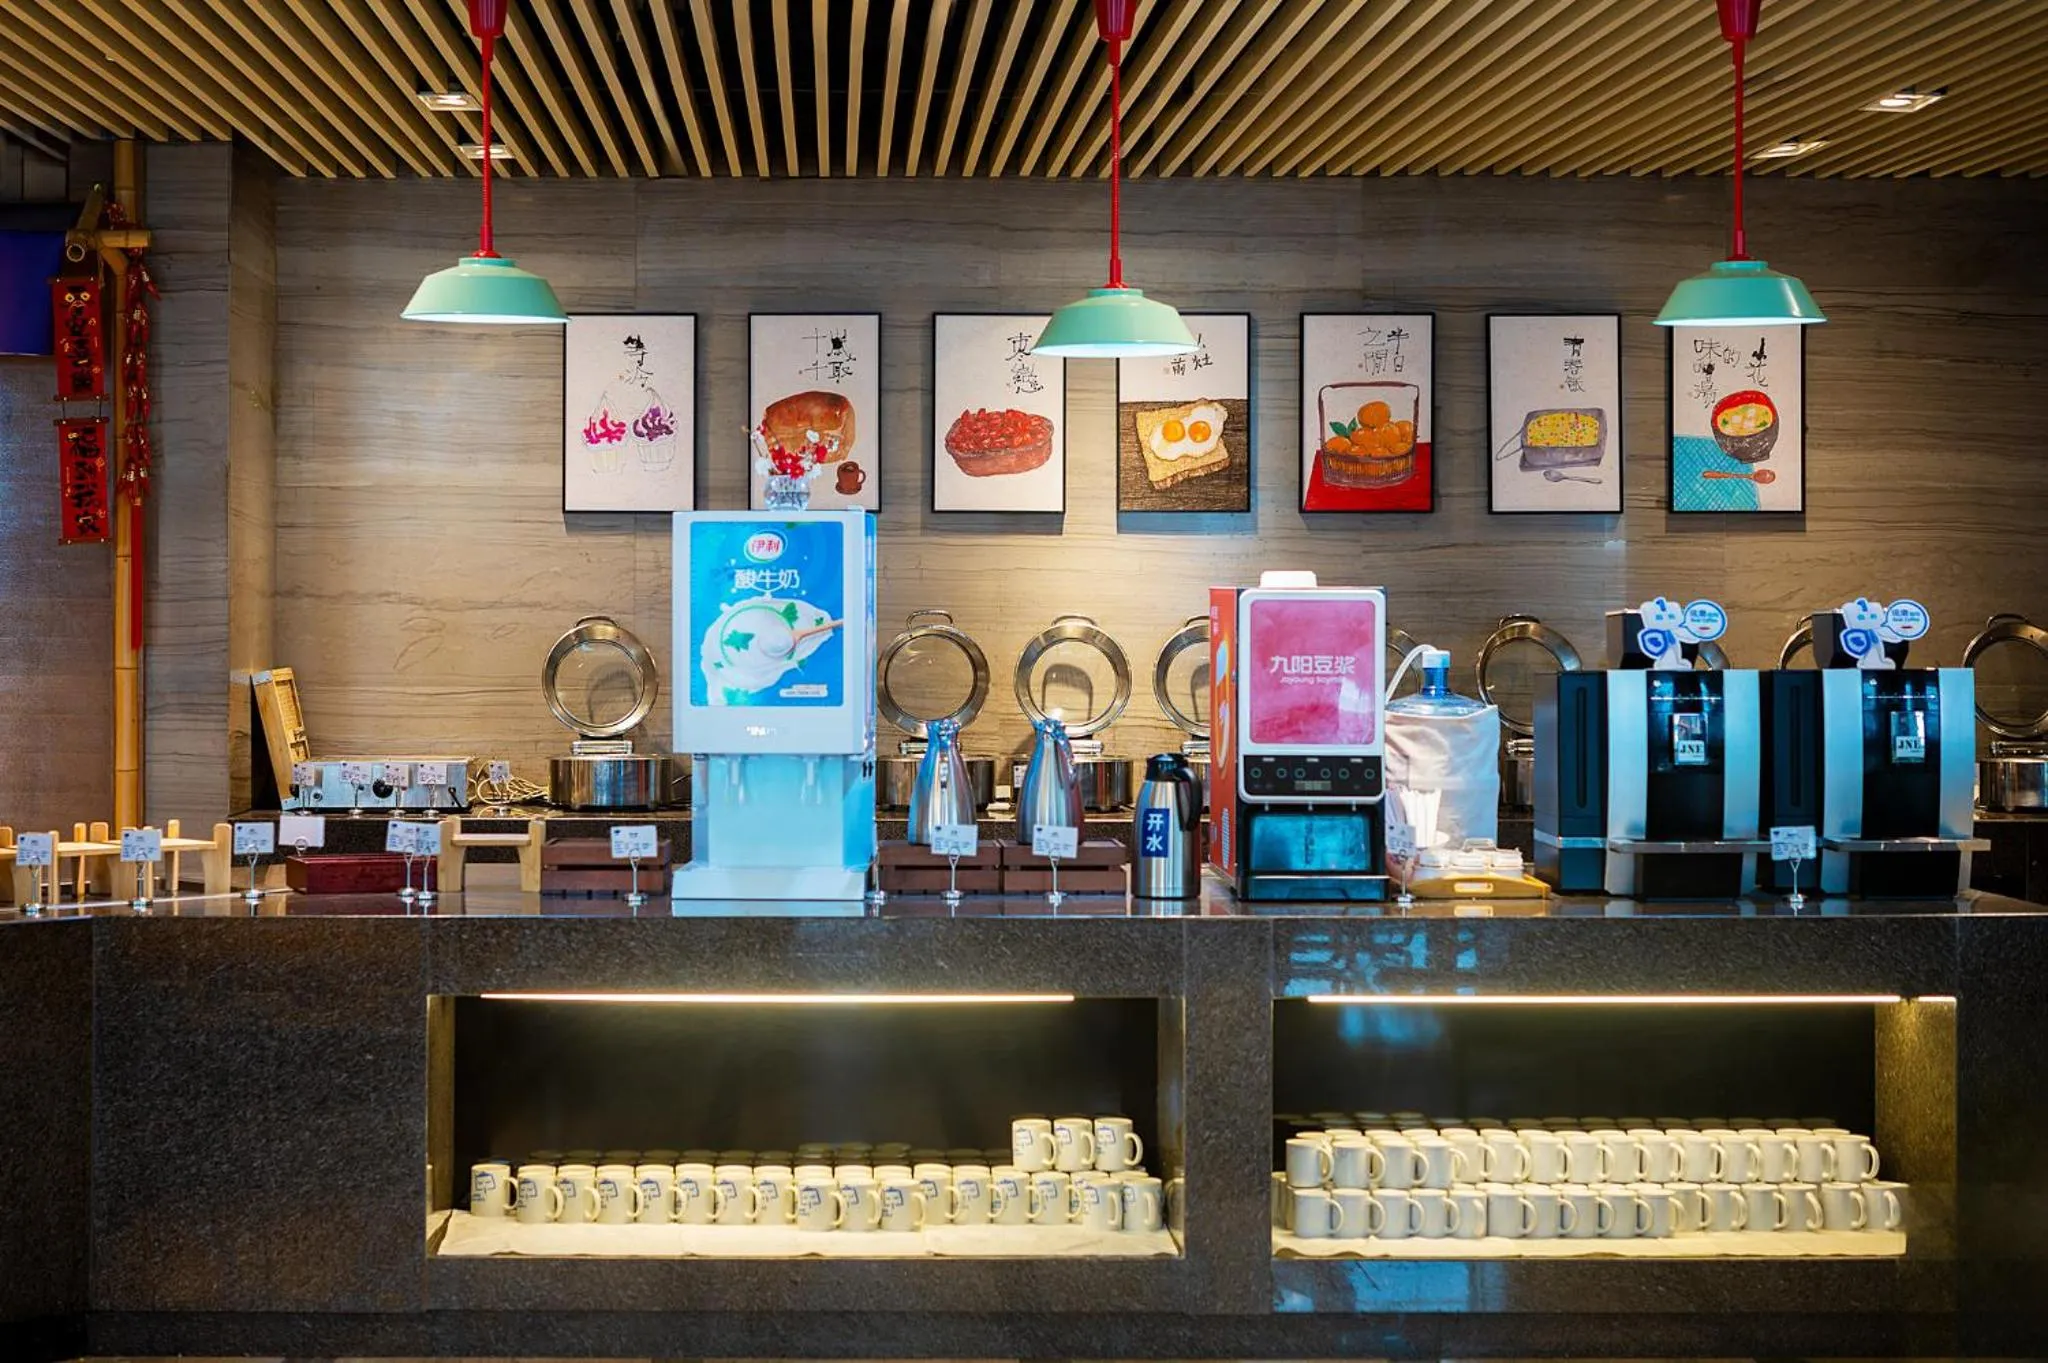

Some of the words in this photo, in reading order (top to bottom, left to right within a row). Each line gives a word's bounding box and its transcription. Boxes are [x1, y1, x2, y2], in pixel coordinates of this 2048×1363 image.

[751, 539, 780, 553] 伊利
[734, 568, 800, 590] 酸牛奶
[1269, 655, 1356, 674] 九阳豆浆
[1146, 813, 1164, 851] 开水
